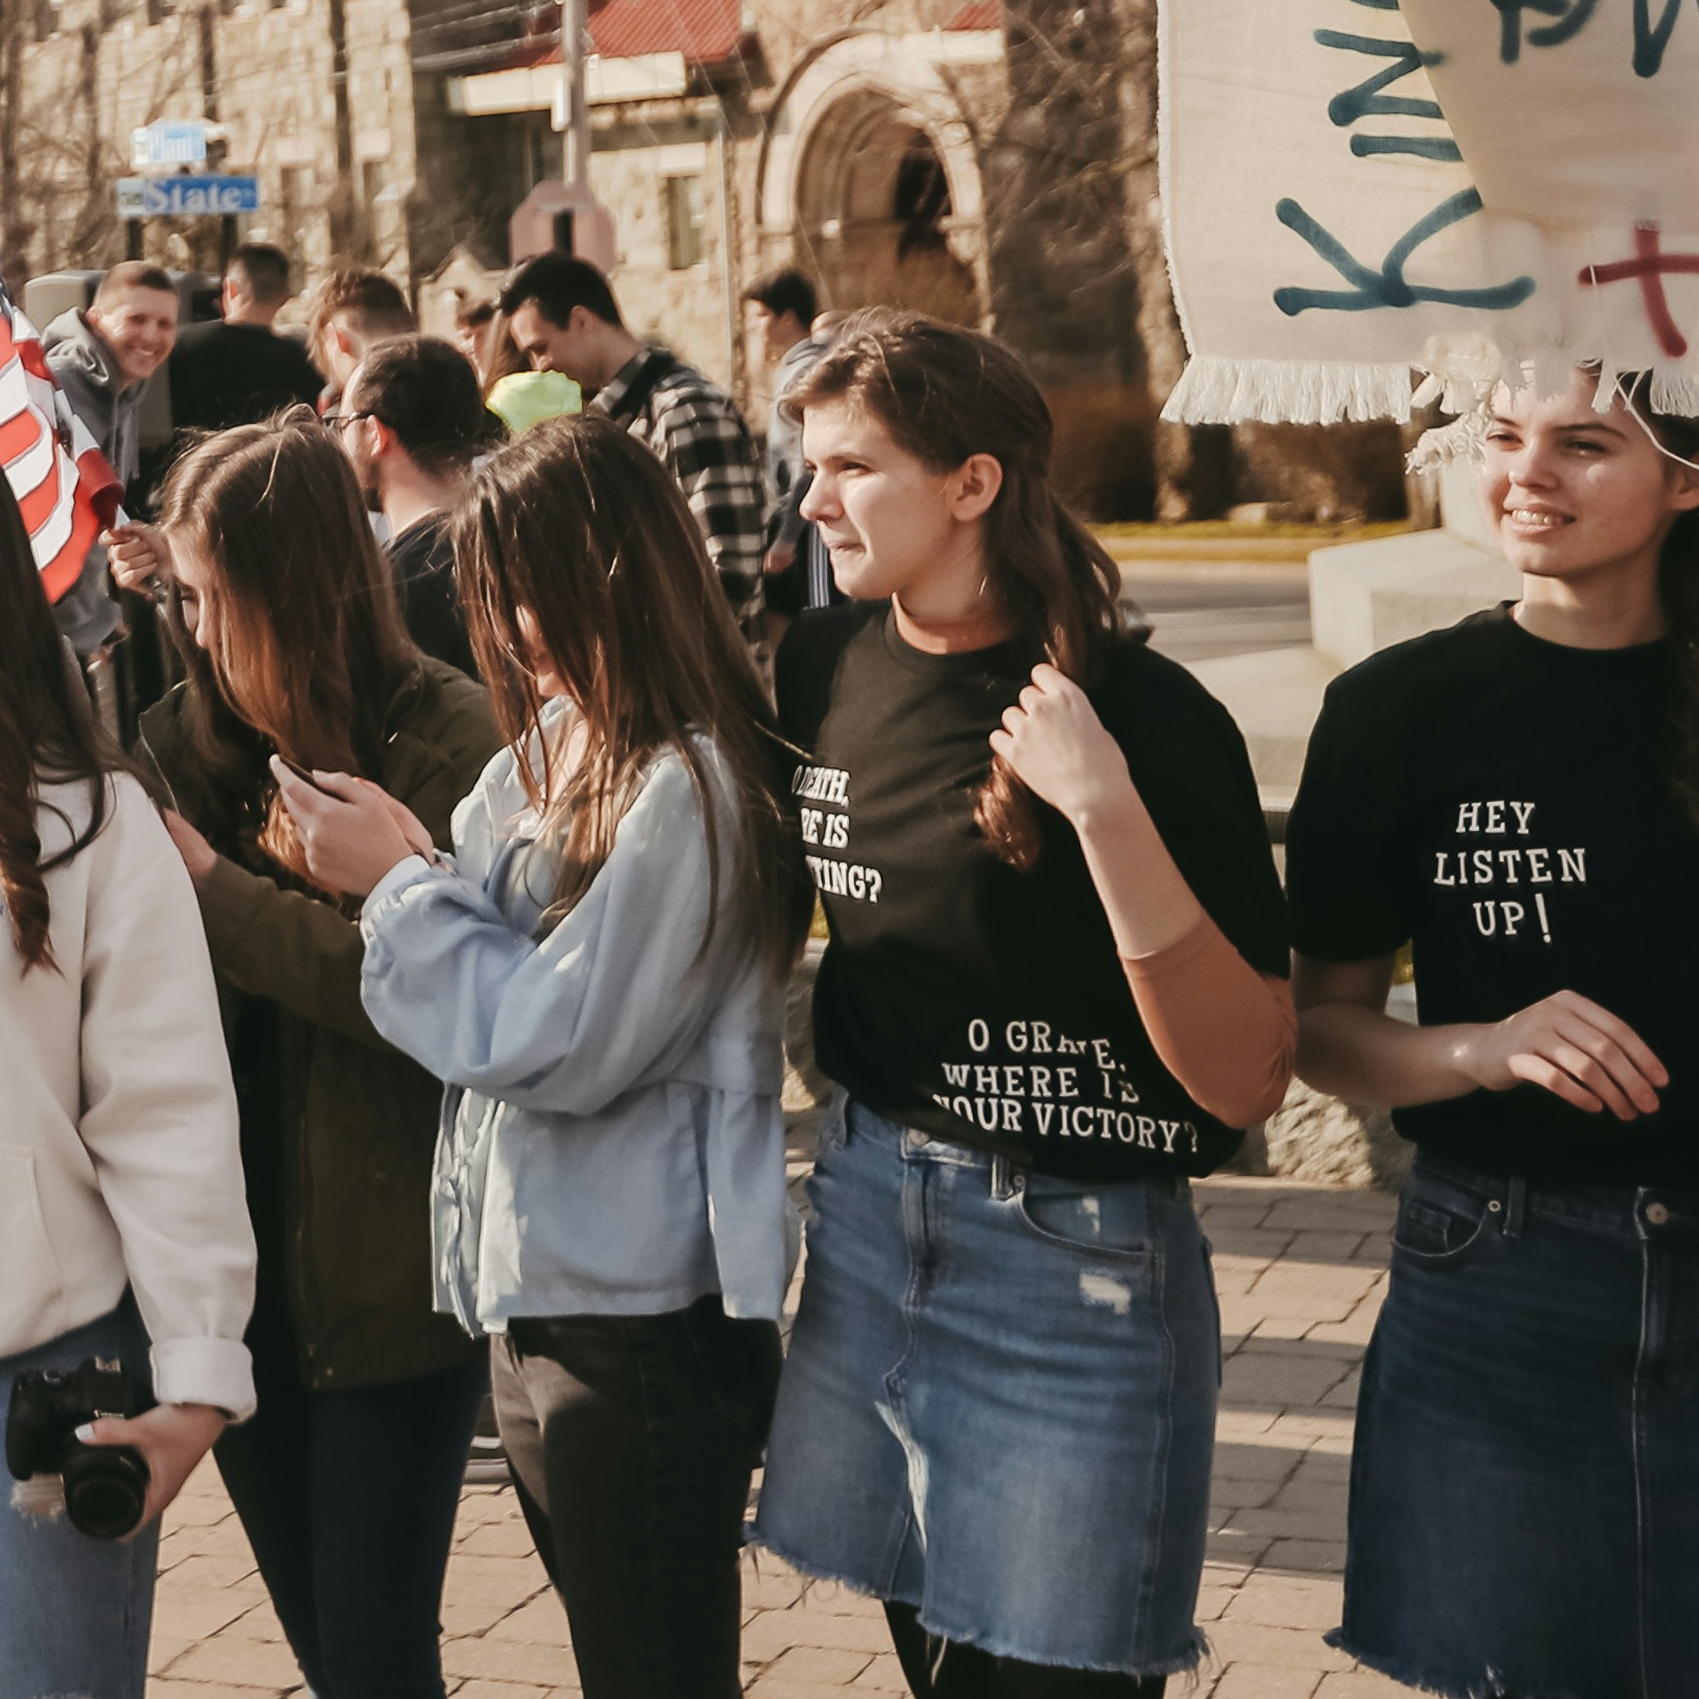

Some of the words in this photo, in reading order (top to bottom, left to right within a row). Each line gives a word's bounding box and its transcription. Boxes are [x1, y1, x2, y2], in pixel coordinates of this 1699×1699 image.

[146, 180, 242, 213] State
[823, 813, 850, 849] IS
[1456, 800, 1535, 834] HEY
[804, 855, 882, 904] TING?
[1433, 848, 1587, 886] LISTEN
[1473, 893, 1552, 944] UP!
[968, 1018, 990, 1052] O
[941, 1062, 1079, 1098] WHERE
[1031, 1102, 1199, 1153] VICTORY?
